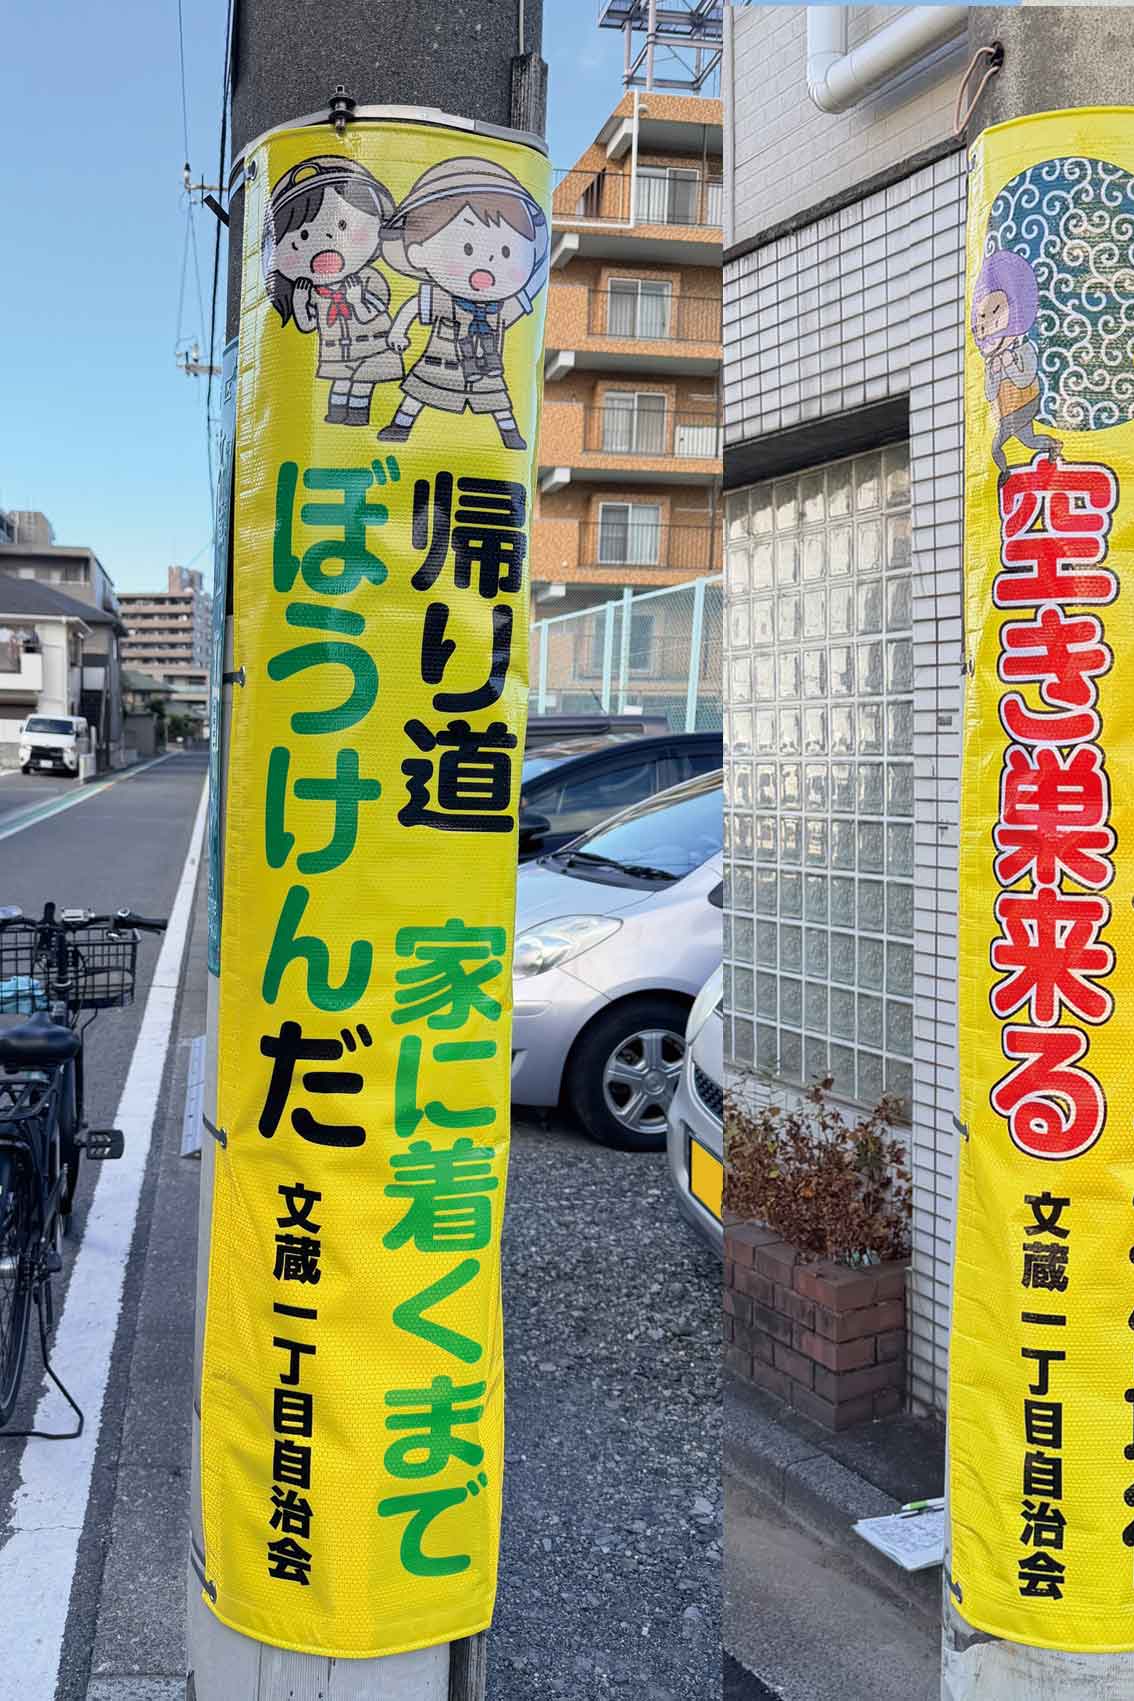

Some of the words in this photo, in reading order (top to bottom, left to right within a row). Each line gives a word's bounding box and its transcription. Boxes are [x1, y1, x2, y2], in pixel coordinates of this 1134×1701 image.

[258, 455, 401, 1148] ぼうけんだ
[397, 470, 528, 834] 帰り道
[988, 450, 1120, 1161] 空き巣来る
[266, 1181, 323, 1588] 文蔵一丁目自治会
[377, 917, 508, 1578] 家に着くまで
[1018, 1190, 1071, 1601] 文蔵一丁目自治会
